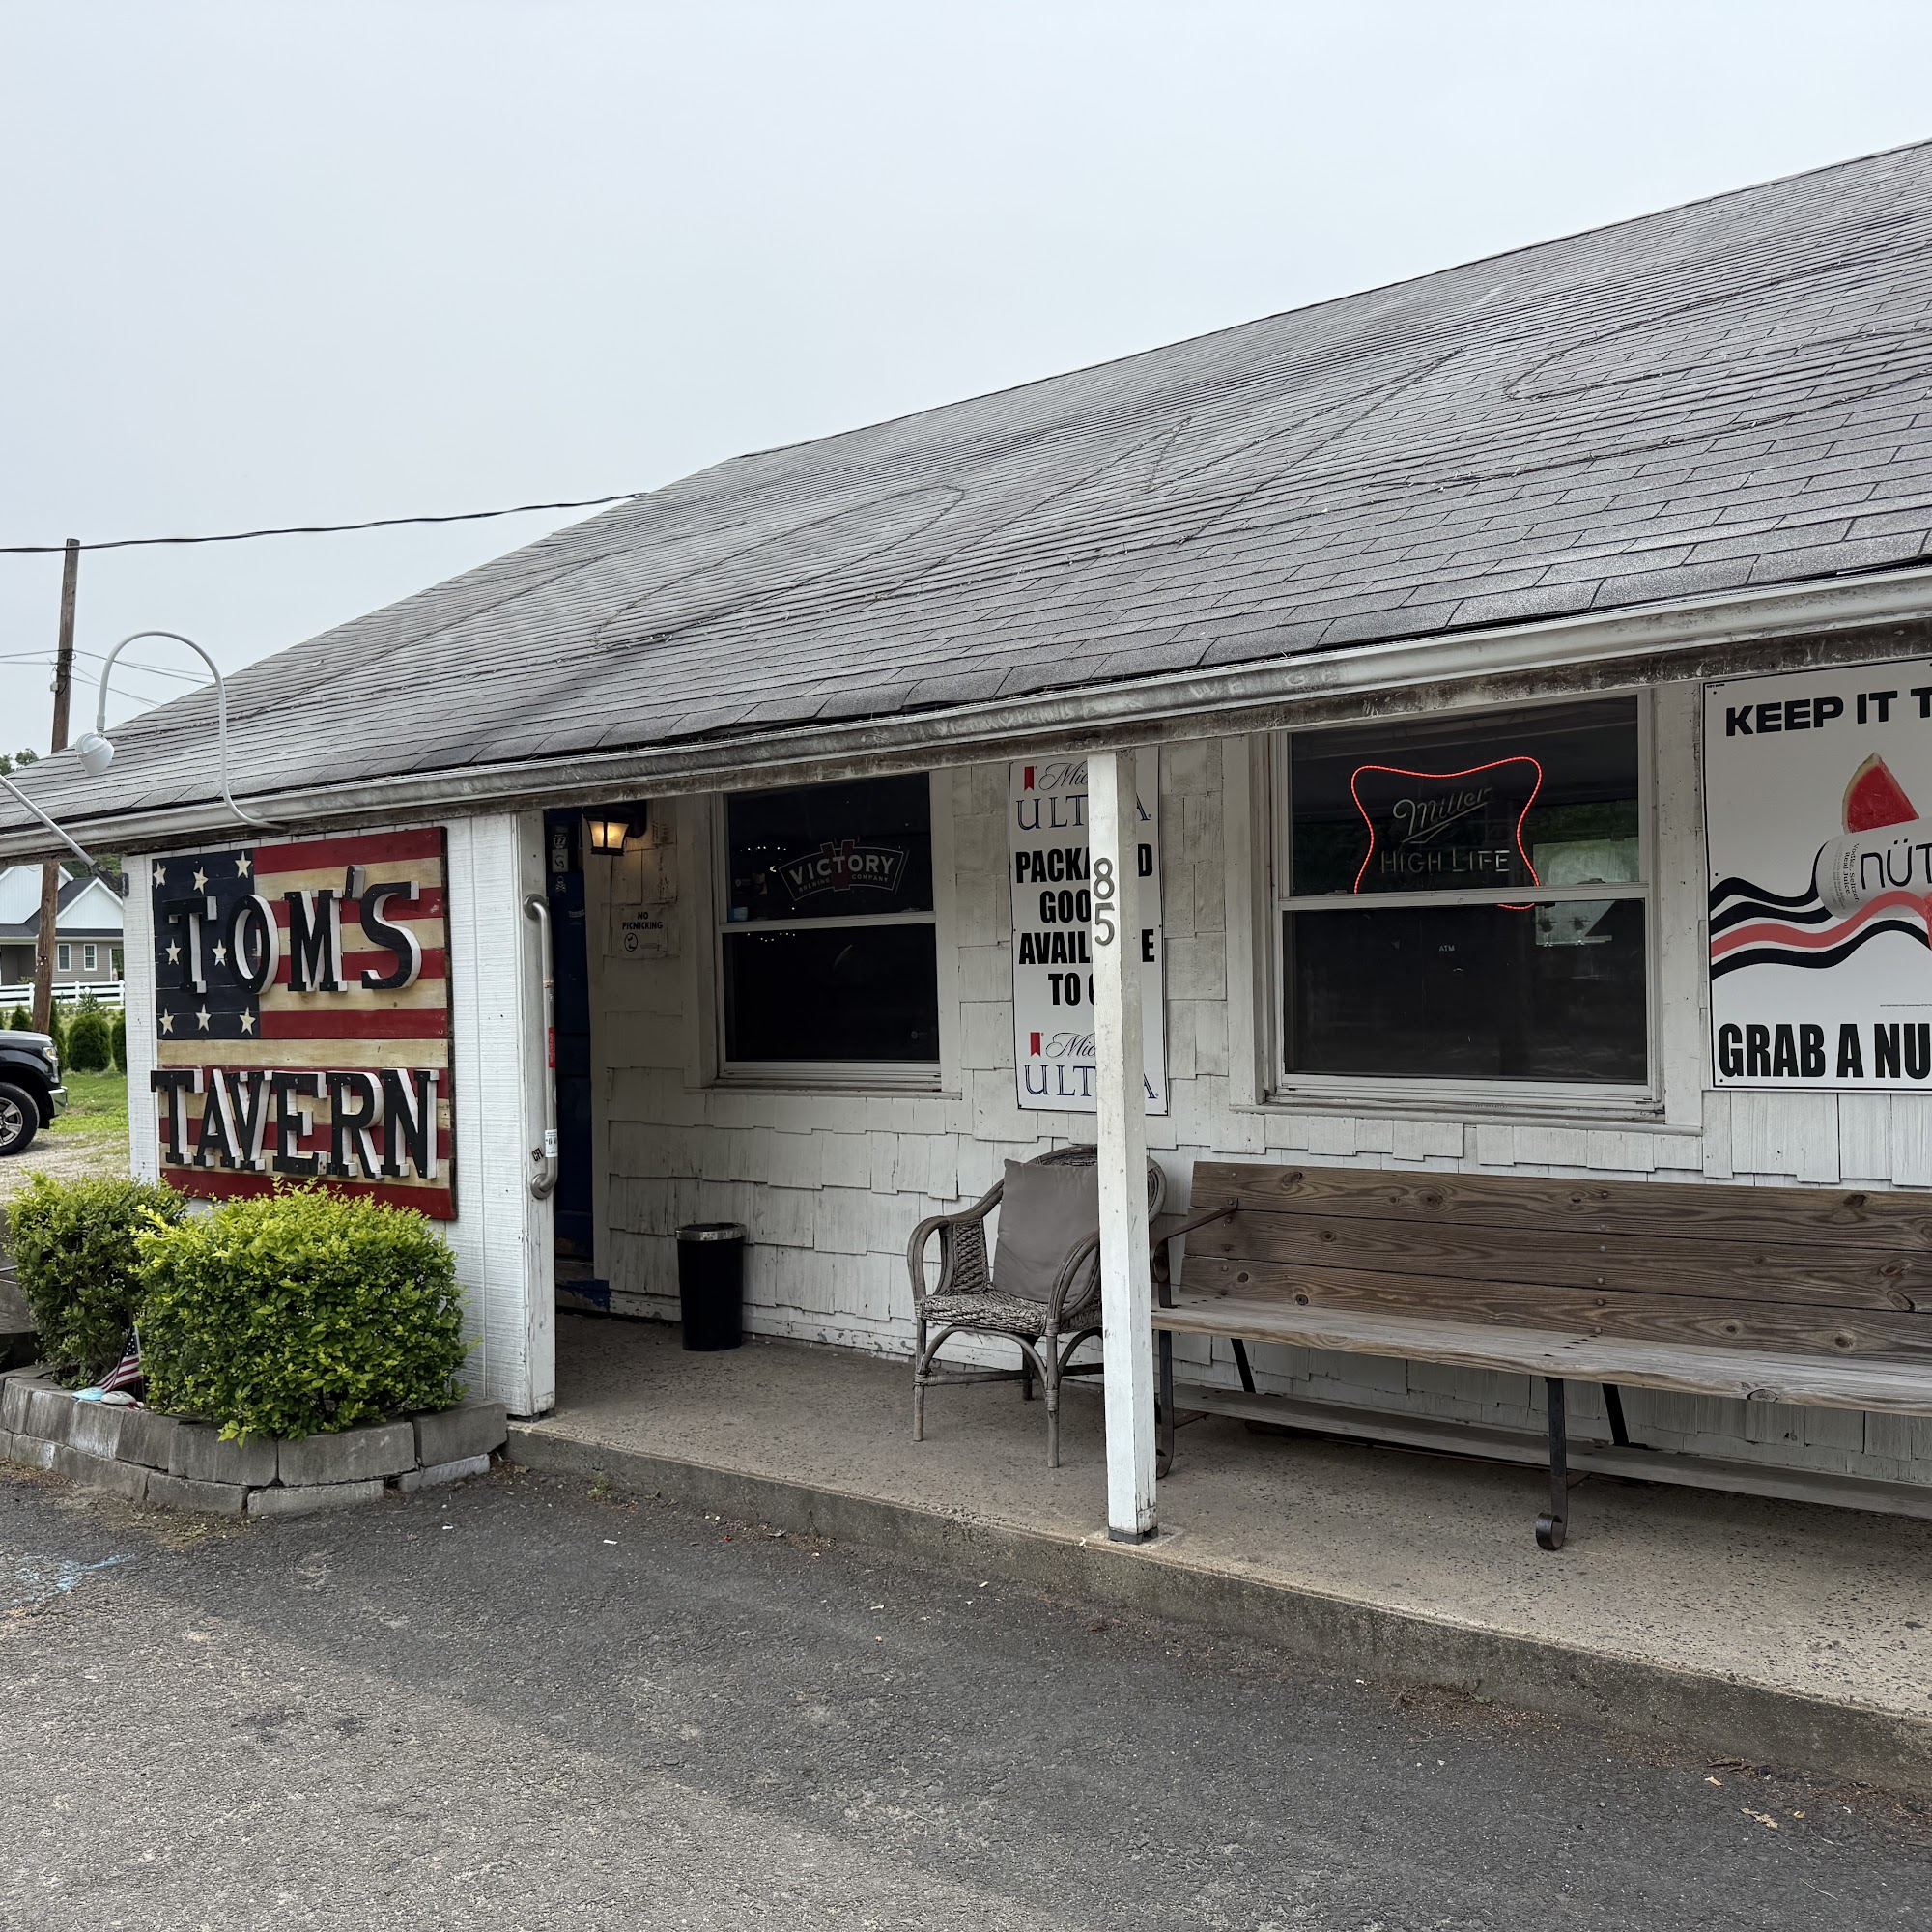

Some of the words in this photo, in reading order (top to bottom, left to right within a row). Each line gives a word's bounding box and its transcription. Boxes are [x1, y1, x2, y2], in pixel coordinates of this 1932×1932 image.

[1726, 696, 1844, 737] KEEP
[1857, 690, 1898, 724] IT
[1393, 787, 1492, 836] Miller
[789, 854, 895, 885] VICTORY
[1015, 843, 1153, 884] PACKD
[1380, 850, 1442, 874] HIGH
[1452, 848, 1510, 872] LIFE
[798, 877, 831, 893] BREWING
[851, 873, 889, 883] COMPANY
[638, 911, 649, 921] NO
[1039, 889, 1092, 924] GOO
[162, 866, 422, 995] TOM'S
[622, 921, 664, 931] PICNICKING
[1019, 929, 1155, 965] AVAILE
[1048, 972, 1081, 1007] TO
[1719, 1023, 1826, 1078] GRAB
[1836, 1023, 1864, 1078] A
[150, 1067, 440, 1179] TAVERN
